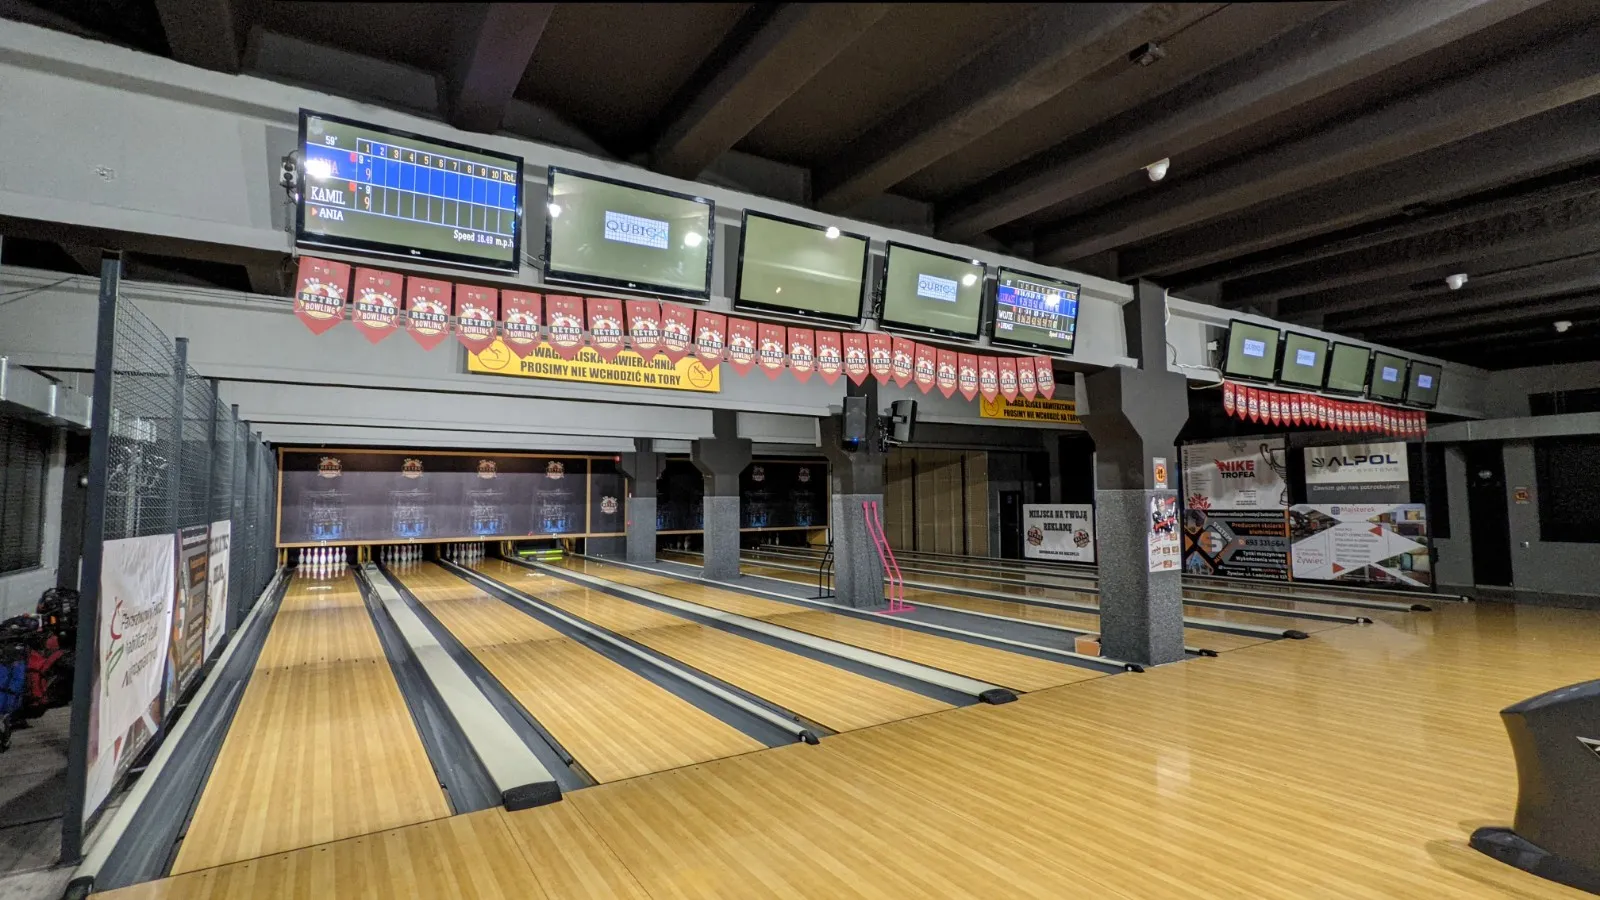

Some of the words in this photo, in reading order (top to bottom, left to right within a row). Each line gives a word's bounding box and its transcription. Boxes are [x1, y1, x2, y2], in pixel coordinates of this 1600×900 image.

[492, 170, 499, 179] 10
[310, 186, 345, 205] KAMIL
[319, 208, 344, 221] ANIA
[606, 220, 668, 241] QUBICA
[453, 230, 475, 242] Speed
[303, 294, 340, 306] RETRO
[306, 303, 335, 314] BOWLING
[360, 304, 394, 314] RETRO
[362, 312, 390, 322] BOWLING
[412, 312, 445, 321] RETRO
[415, 320, 442, 329] BOWLING
[461, 318, 491, 327] RETRO
[508, 323, 536, 331] RETRO
[464, 326, 489, 335] BOWLING
[556, 333, 578, 341] BOWLING
[664, 332, 688, 341] RETRO
[699, 340, 721, 348] RETRO
[528, 347, 562, 360] WAG
[572, 352, 603, 364] LISKA
[606, 356, 676, 370] AWIERZCHNIA
[520, 361, 568, 376] PROSIMY
[571, 366, 587, 377] NIE
[589, 368, 641, 382] WCHODZIĆ
[644, 373, 656, 383] NA
[658, 374, 681, 385] TORY
[1220, 460, 1254, 471] NIKE
[1328, 454, 1398, 467] ALPOL
[1055, 510, 1064, 518] NA
[1044, 523, 1072, 534] REKLAMĘ
